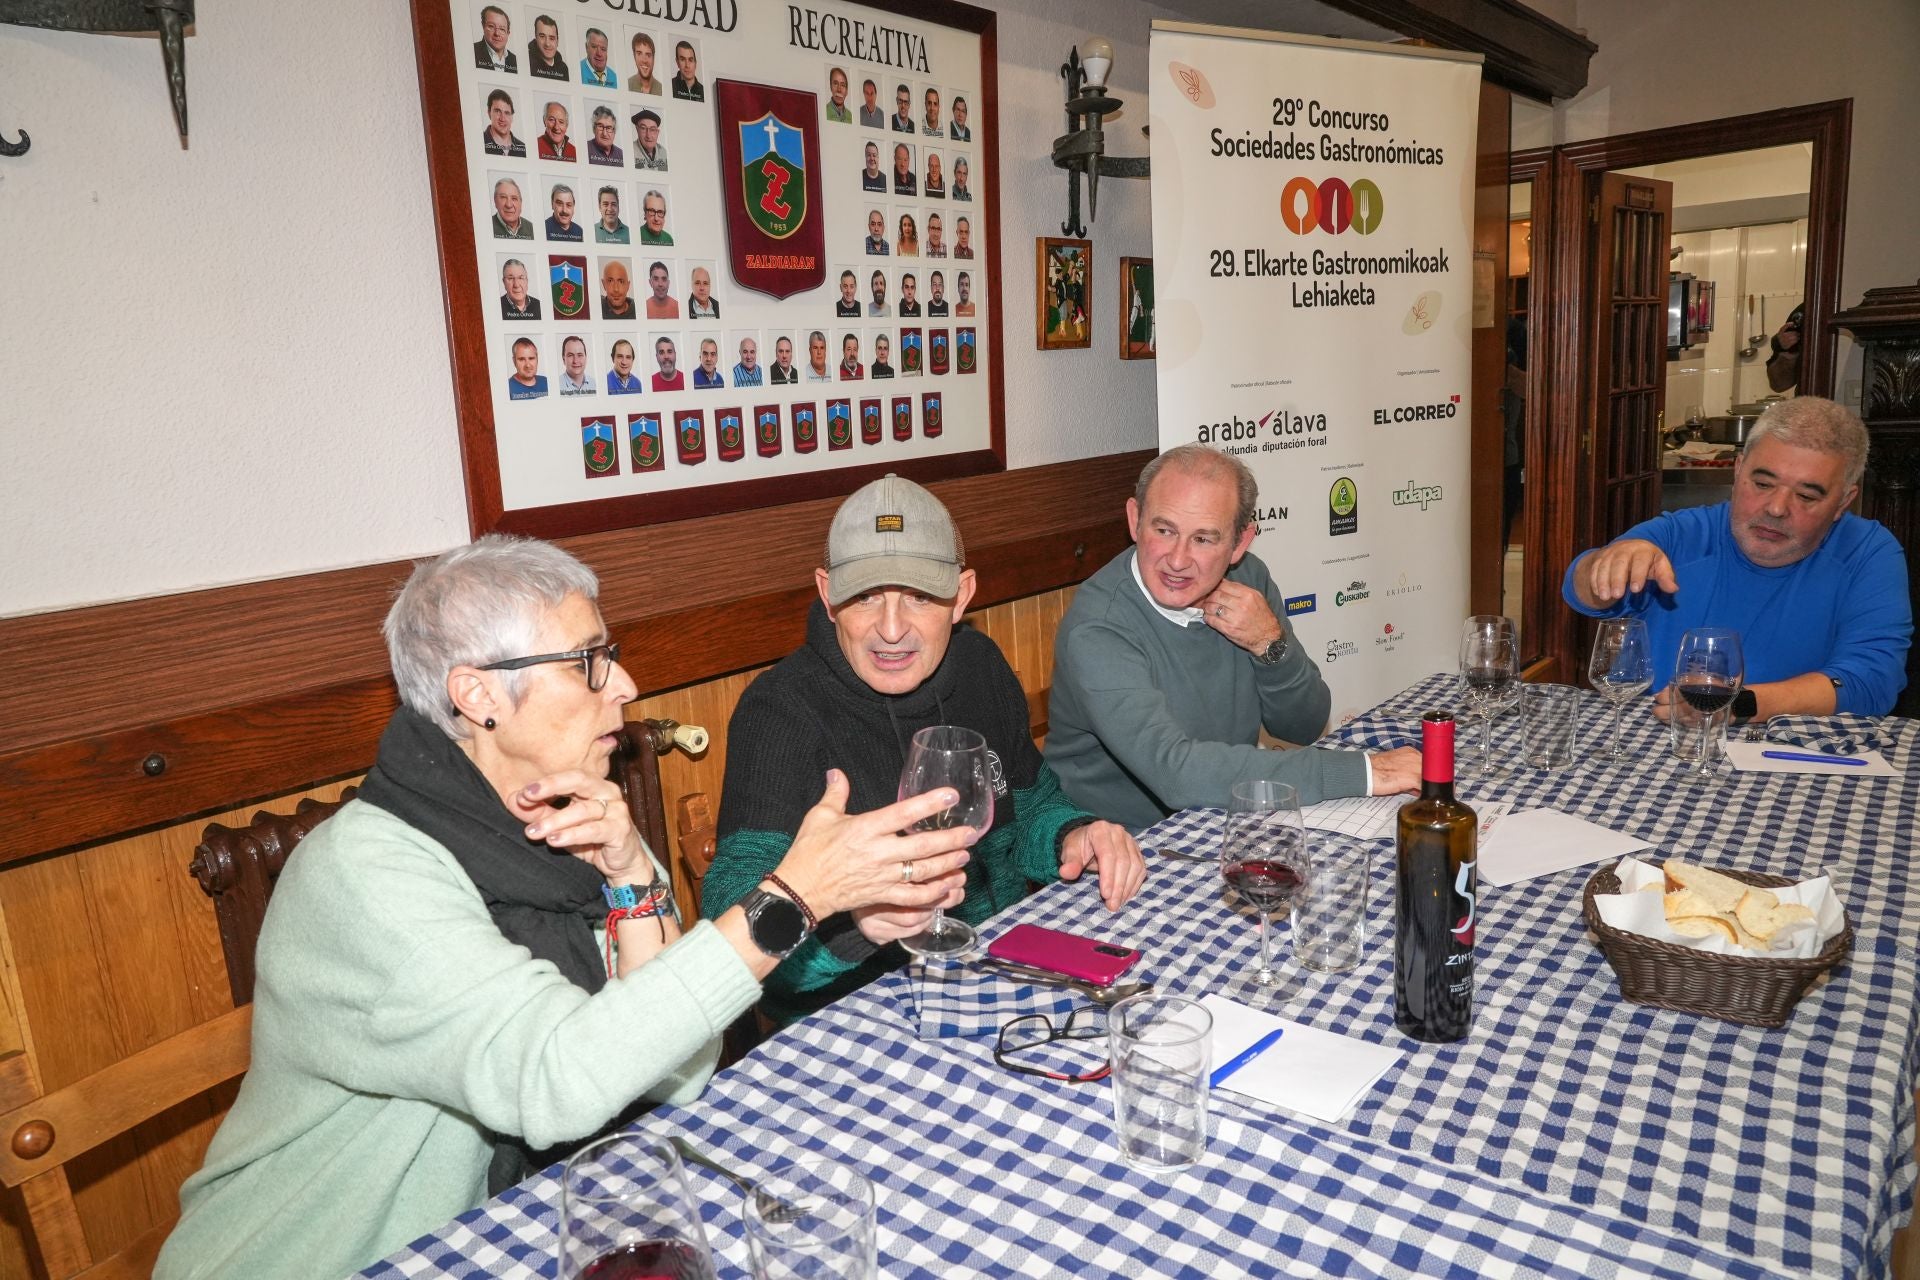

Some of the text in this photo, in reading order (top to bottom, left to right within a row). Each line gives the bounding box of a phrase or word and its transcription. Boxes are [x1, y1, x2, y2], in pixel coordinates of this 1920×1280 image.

[788, 5, 931, 74] RECREATIVA
[1308, 100, 1390, 132] Concurso
[1210, 127, 1444, 166] Sociedades Gastronómicas
[770, 221, 787, 231] 1953
[745, 254, 816, 270] ZALDIARAN
[1210, 248, 1450, 278] 29. Elkarte Gastronomikoak
[1291, 280, 1376, 309] Lehiaketa
[1197, 410, 1327, 443] araba álava
[1373, 402, 1457, 425] EL CORREO
[1262, 438, 1306, 453] diputación
[1307, 435, 1327, 447] foral
[1392, 480, 1443, 512] udapa
[1250, 506, 1289, 522] RLAN
[1288, 599, 1313, 611] makro
[1445, 951, 1473, 966] ZINT
